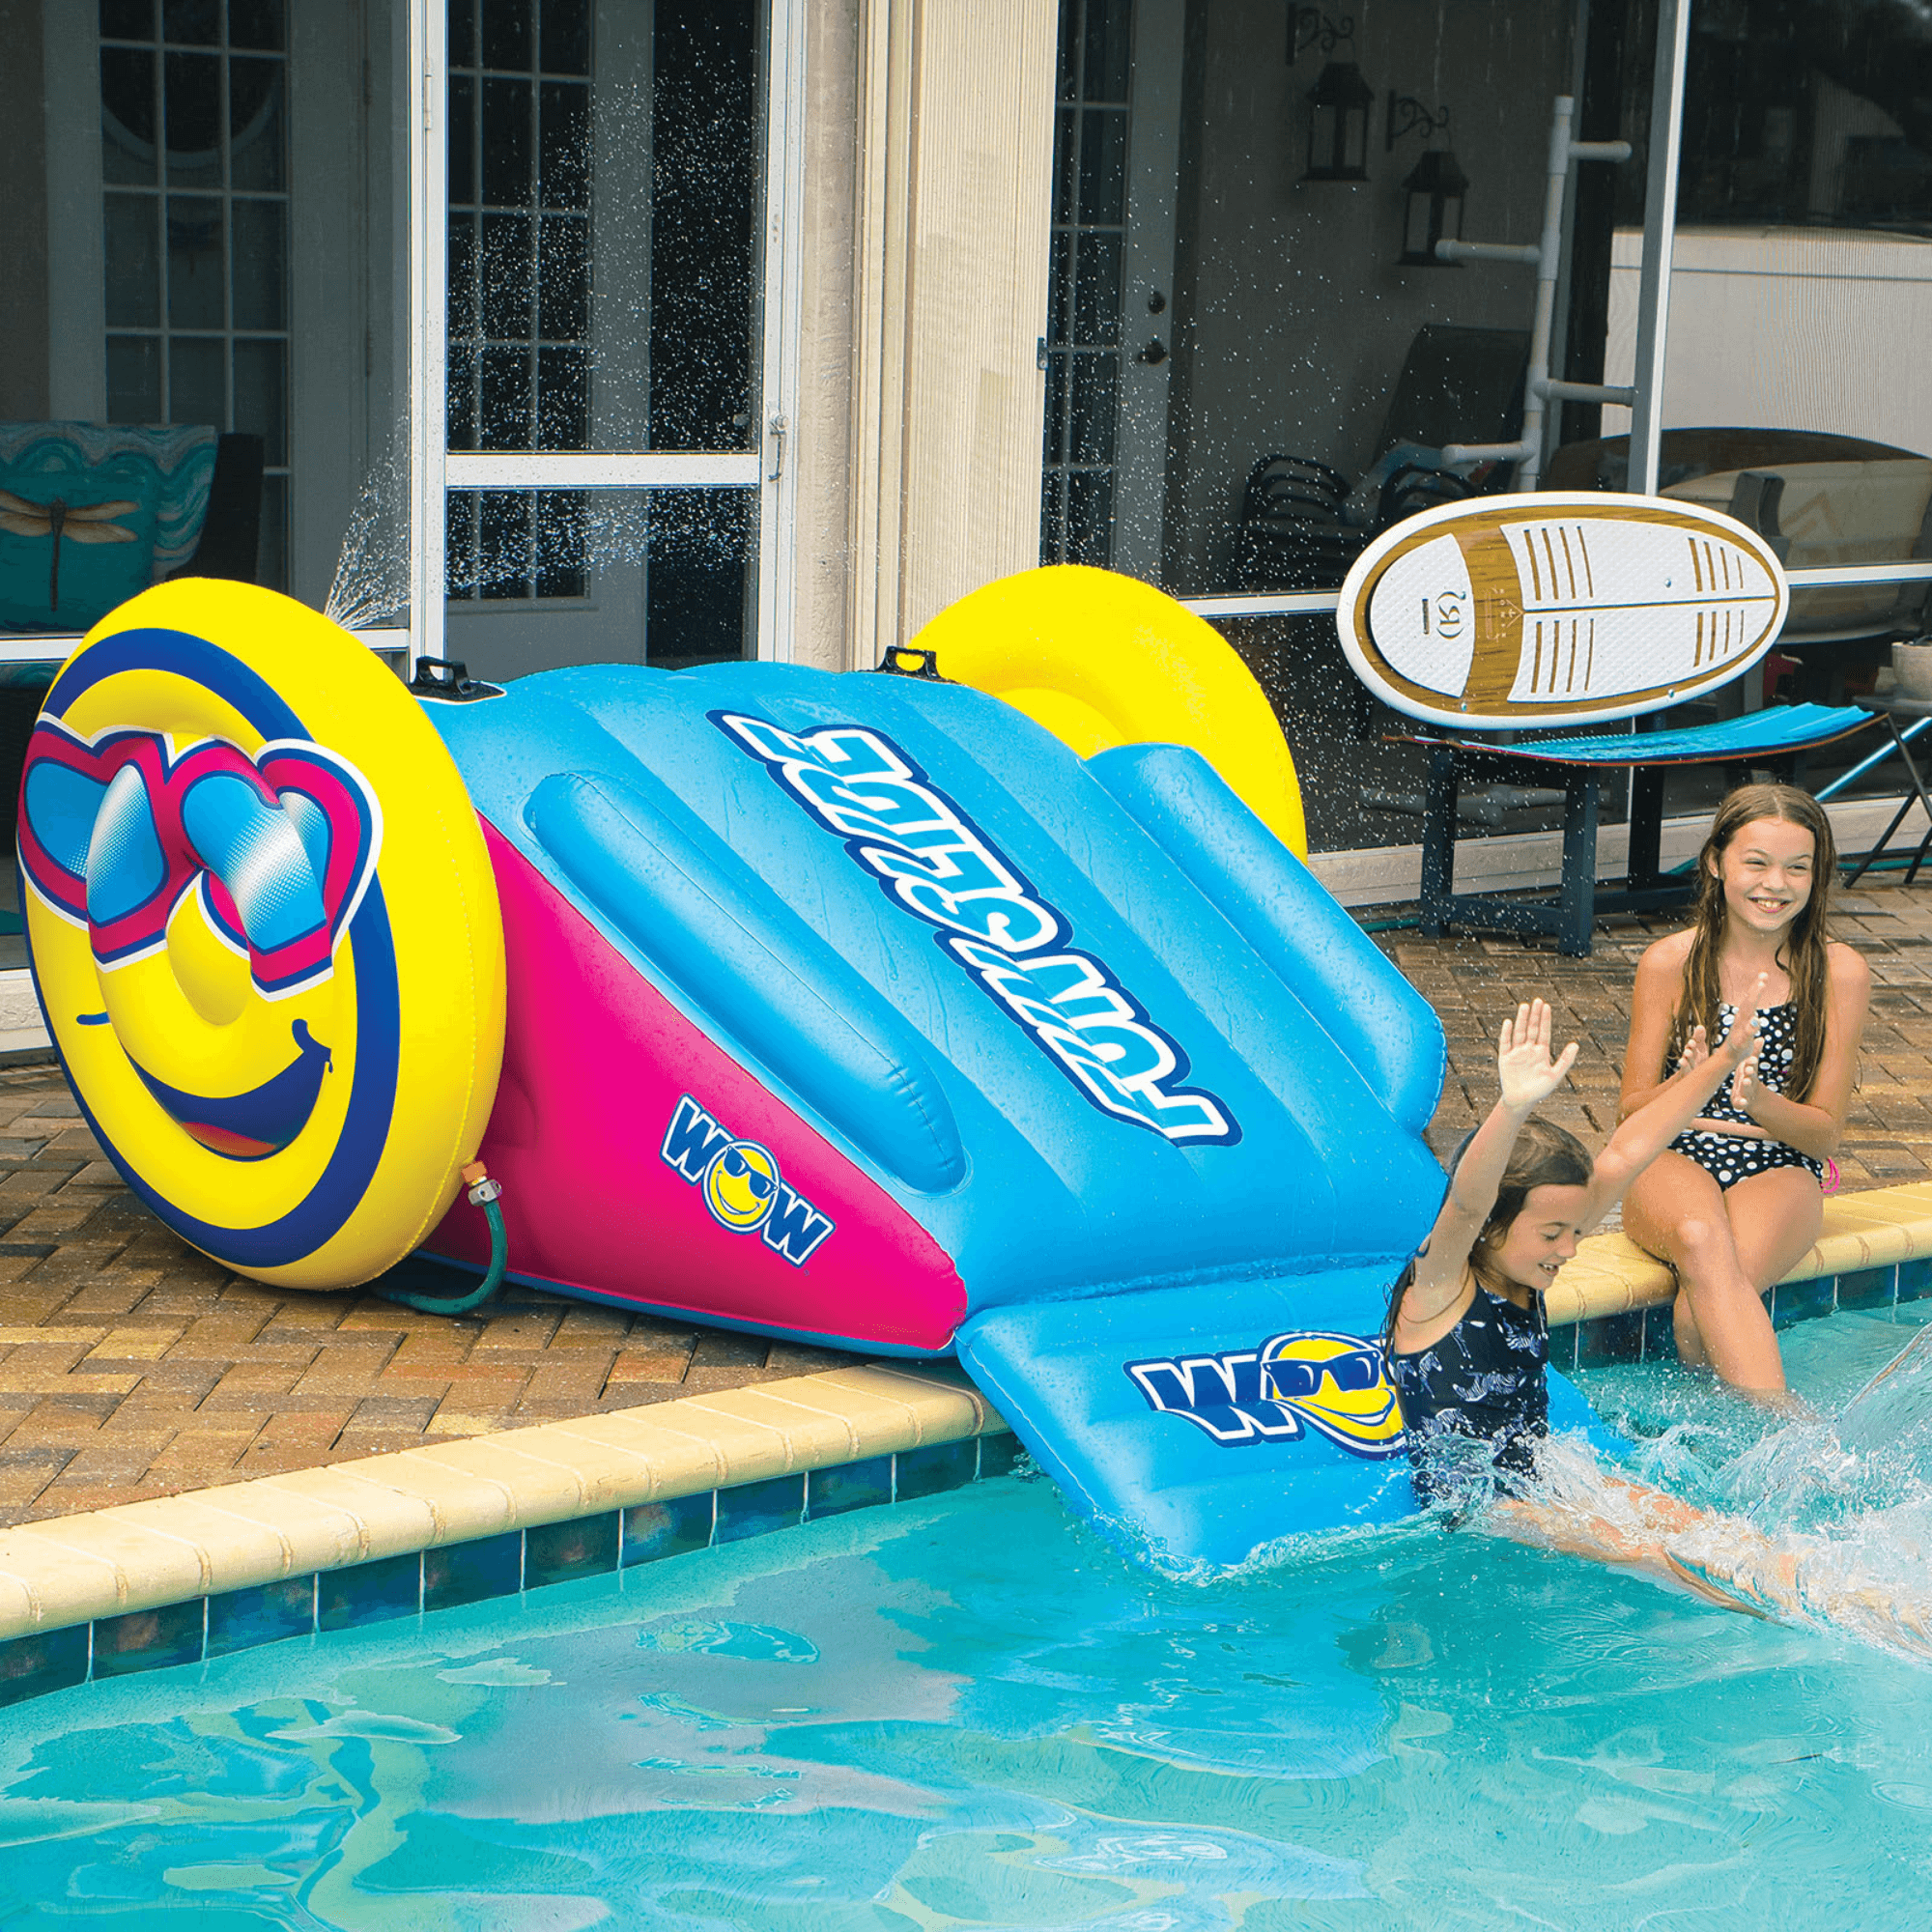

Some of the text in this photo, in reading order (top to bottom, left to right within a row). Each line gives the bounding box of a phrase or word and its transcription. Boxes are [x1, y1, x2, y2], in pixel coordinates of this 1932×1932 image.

[715, 711, 1238, 1142] FUN SLIDE
[660, 1094, 837, 1269] WOW
[1123, 1330, 1408, 1460] WO
